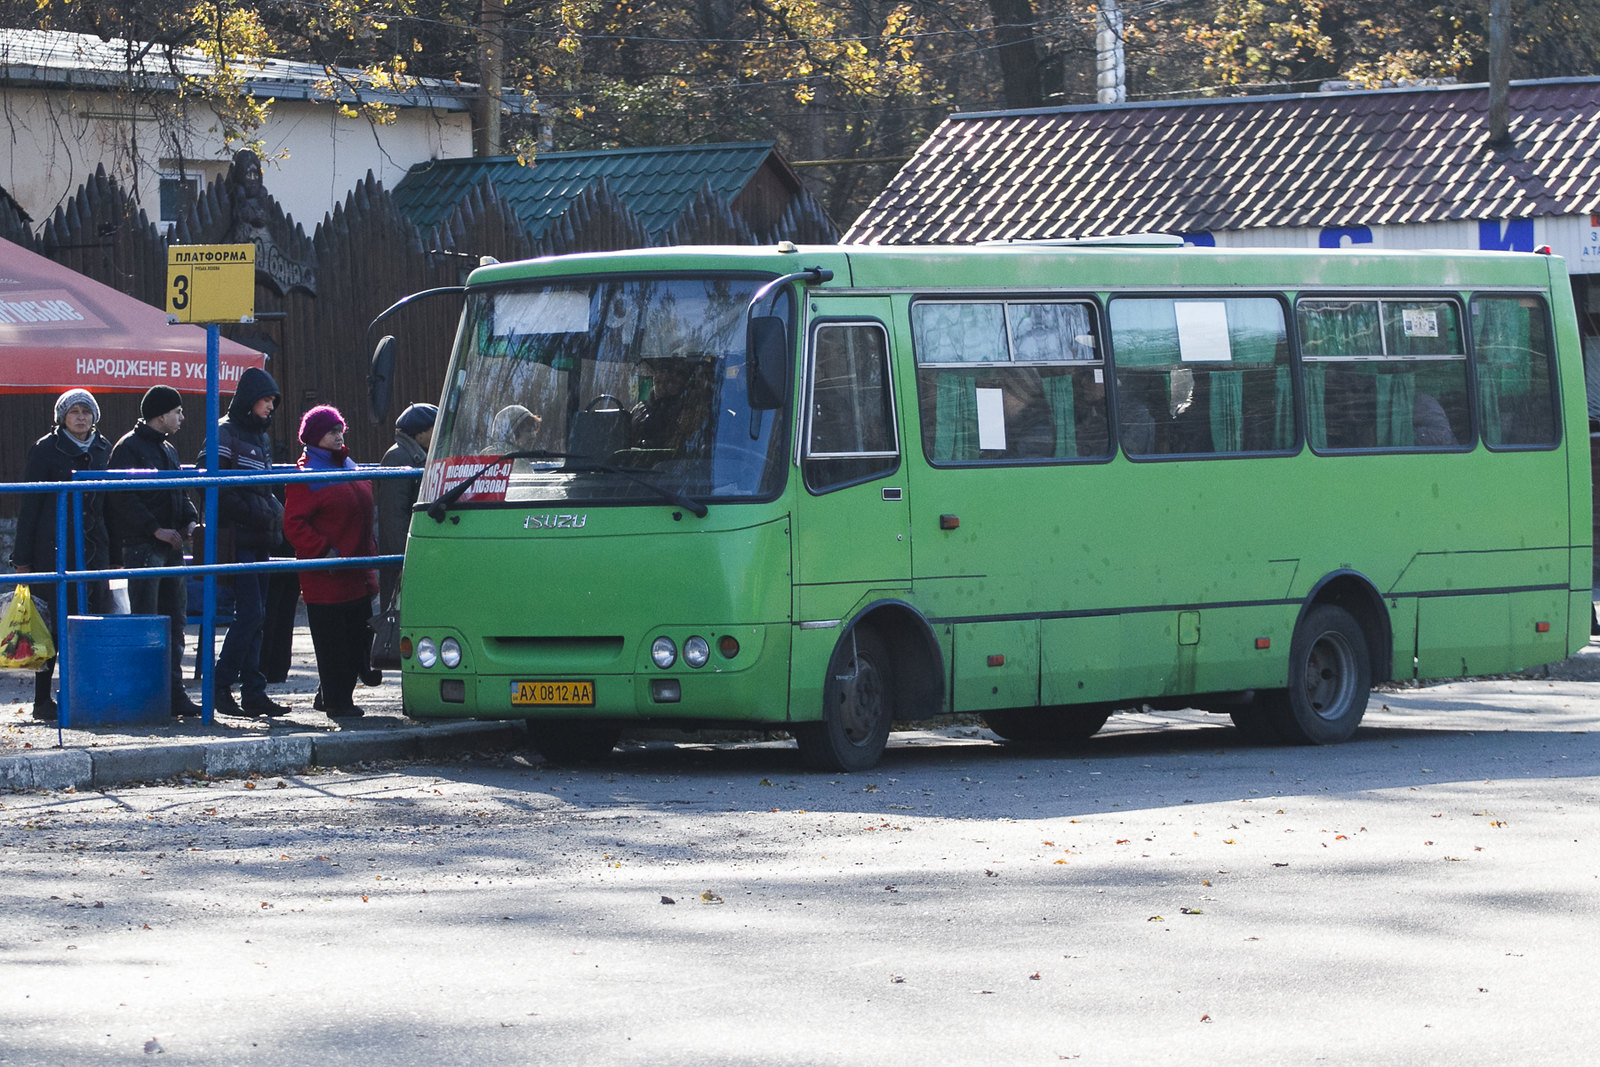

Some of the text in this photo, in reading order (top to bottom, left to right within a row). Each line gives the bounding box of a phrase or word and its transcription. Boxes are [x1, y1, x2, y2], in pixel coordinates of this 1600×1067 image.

[175, 251, 247, 262] ПЛАТФОРМА
[172, 275, 189, 310] 3
[76, 358, 168, 378] НАРОДЖЕНЕ
[171, 363, 181, 378] В
[472, 479, 506, 493] ЛОЗОВА
[523, 514, 587, 529] ISUZU
[520, 685, 590, 701] AX 0812 AA
